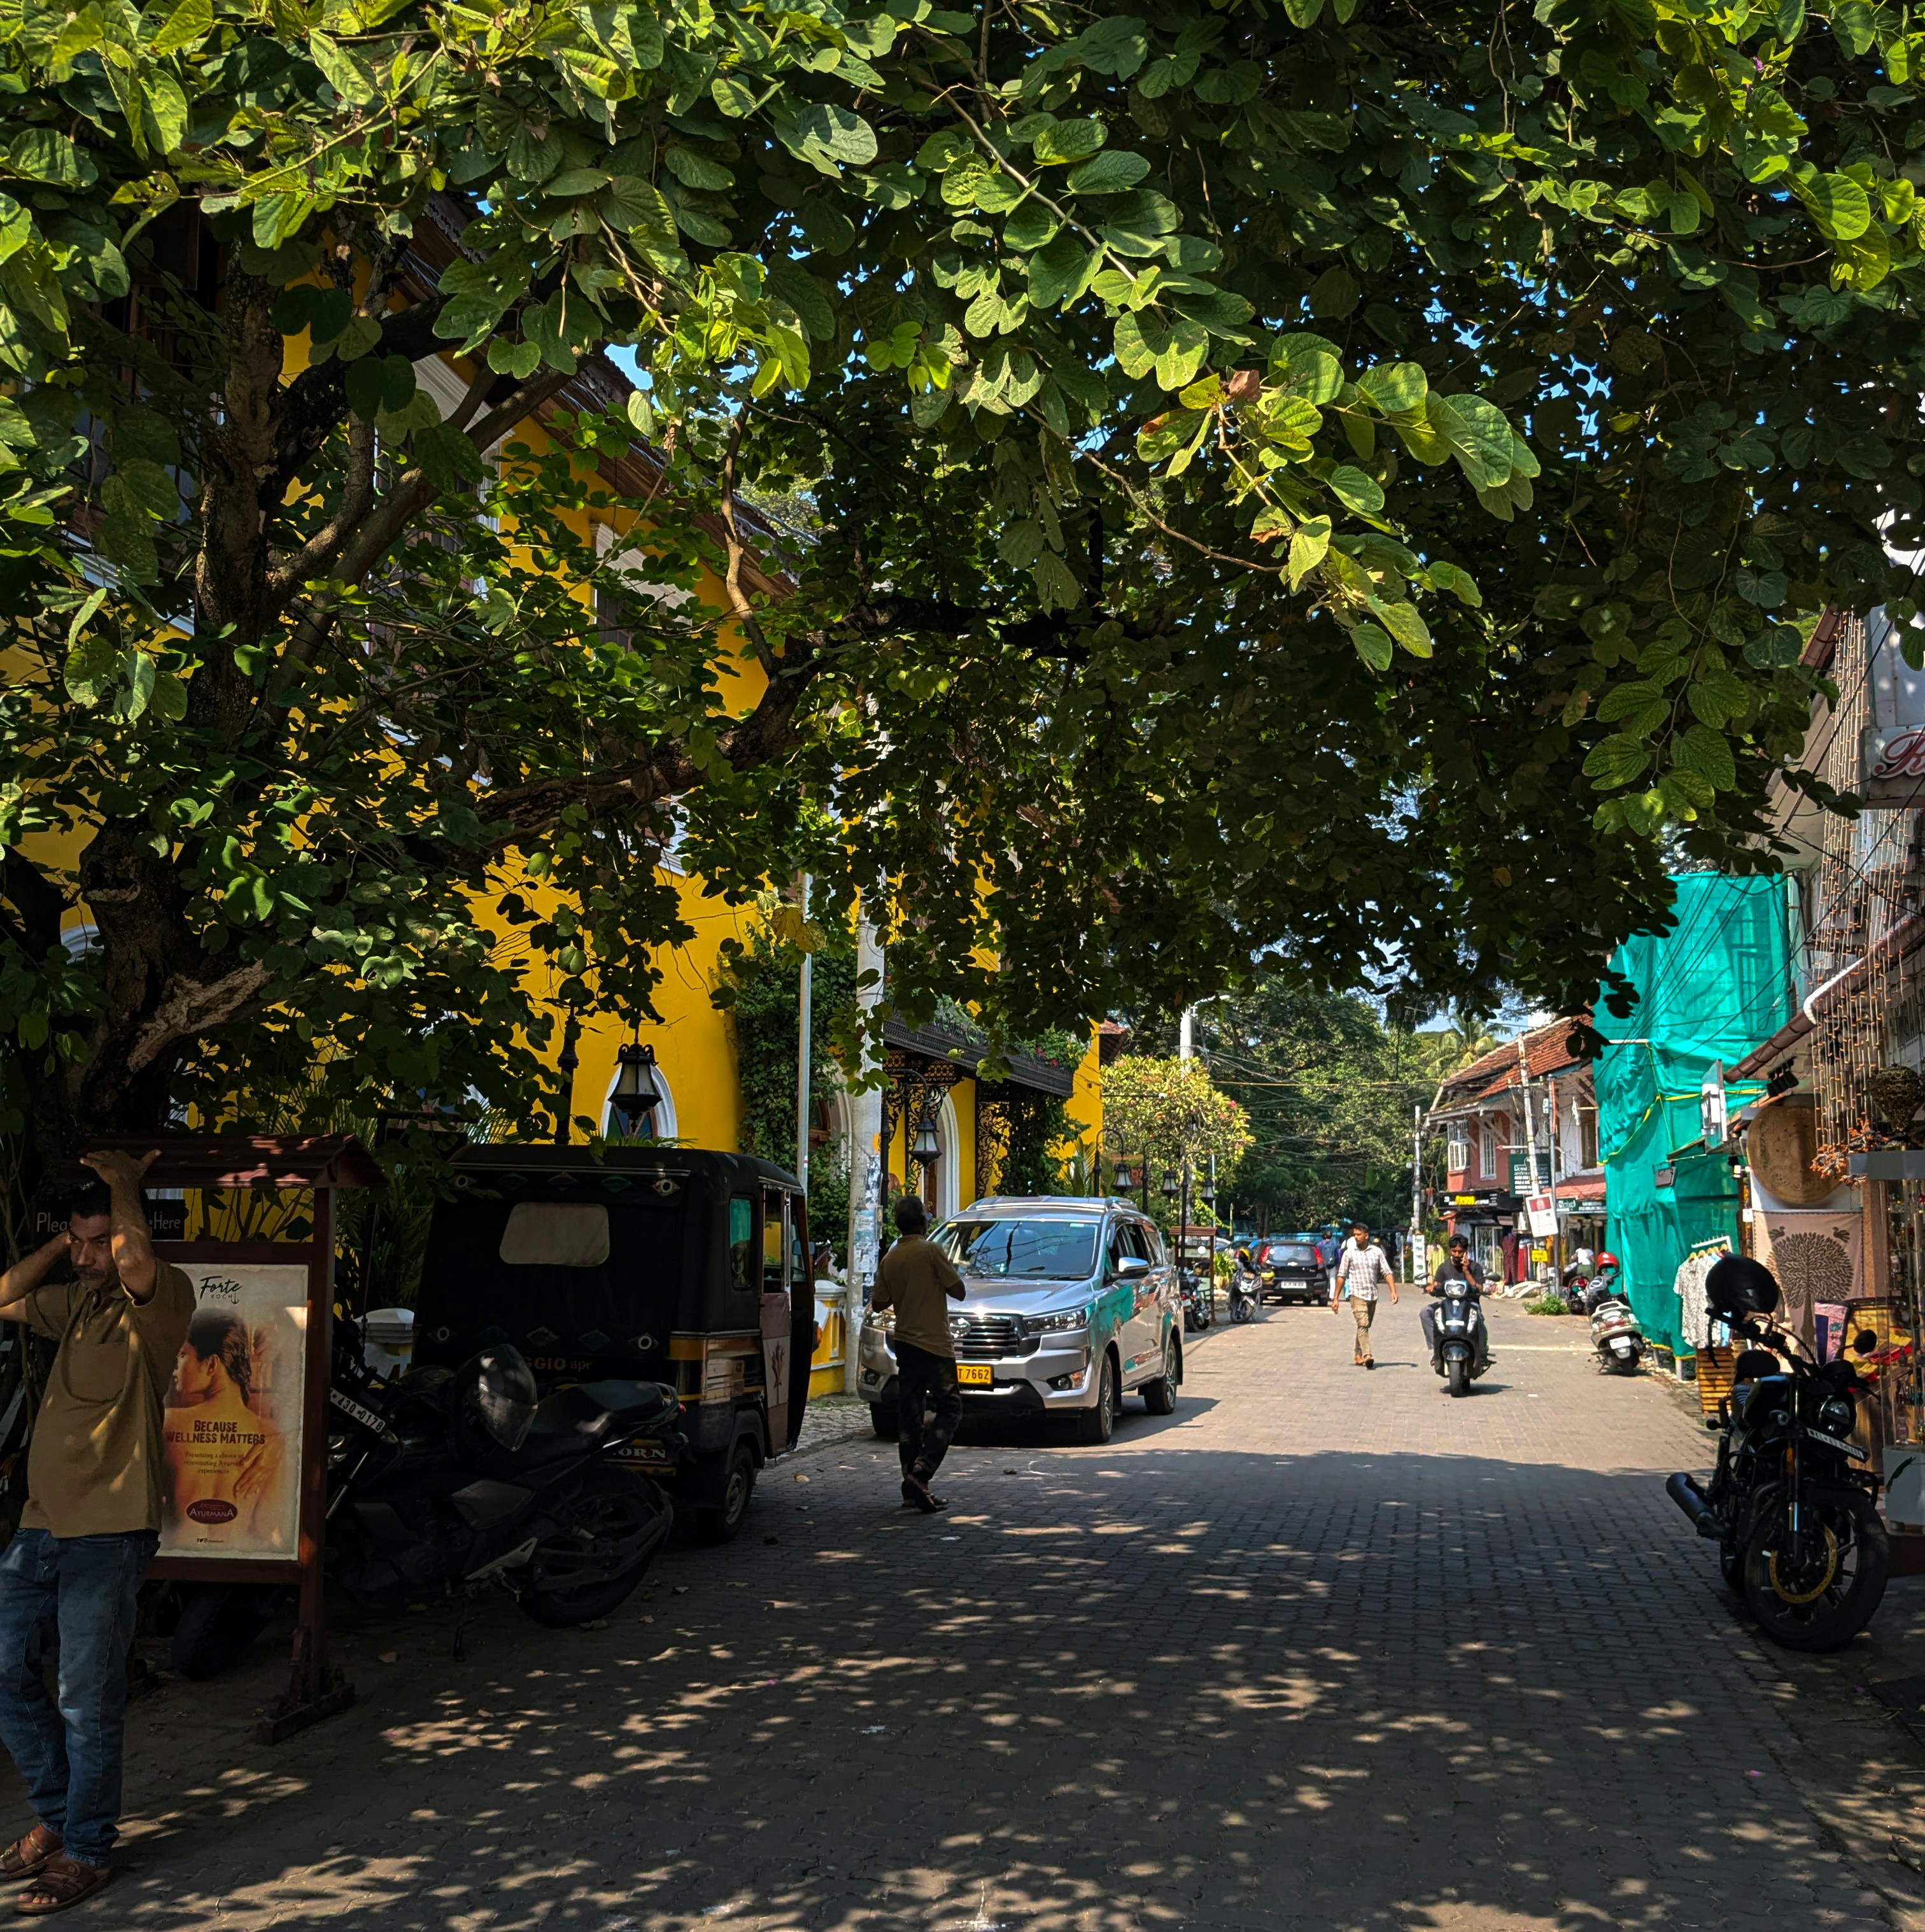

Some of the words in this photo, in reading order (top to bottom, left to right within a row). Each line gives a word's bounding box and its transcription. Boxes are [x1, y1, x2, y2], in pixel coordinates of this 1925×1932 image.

[37, 1212, 71, 1232] Plea
[154, 1211, 181, 1229] Here
[200, 1276, 243, 1299] Forte
[966, 1368, 989, 1380] 7662
[194, 1420, 237, 1432] BECAUSE
[358, 1410, 383, 1430] 0178
[166, 1431, 217, 1443] WELLNESS
[220, 1433, 265, 1444] MATTERS
[612, 1448, 666, 1459] ORN
[190, 1508, 234, 1518] AYURMANA
